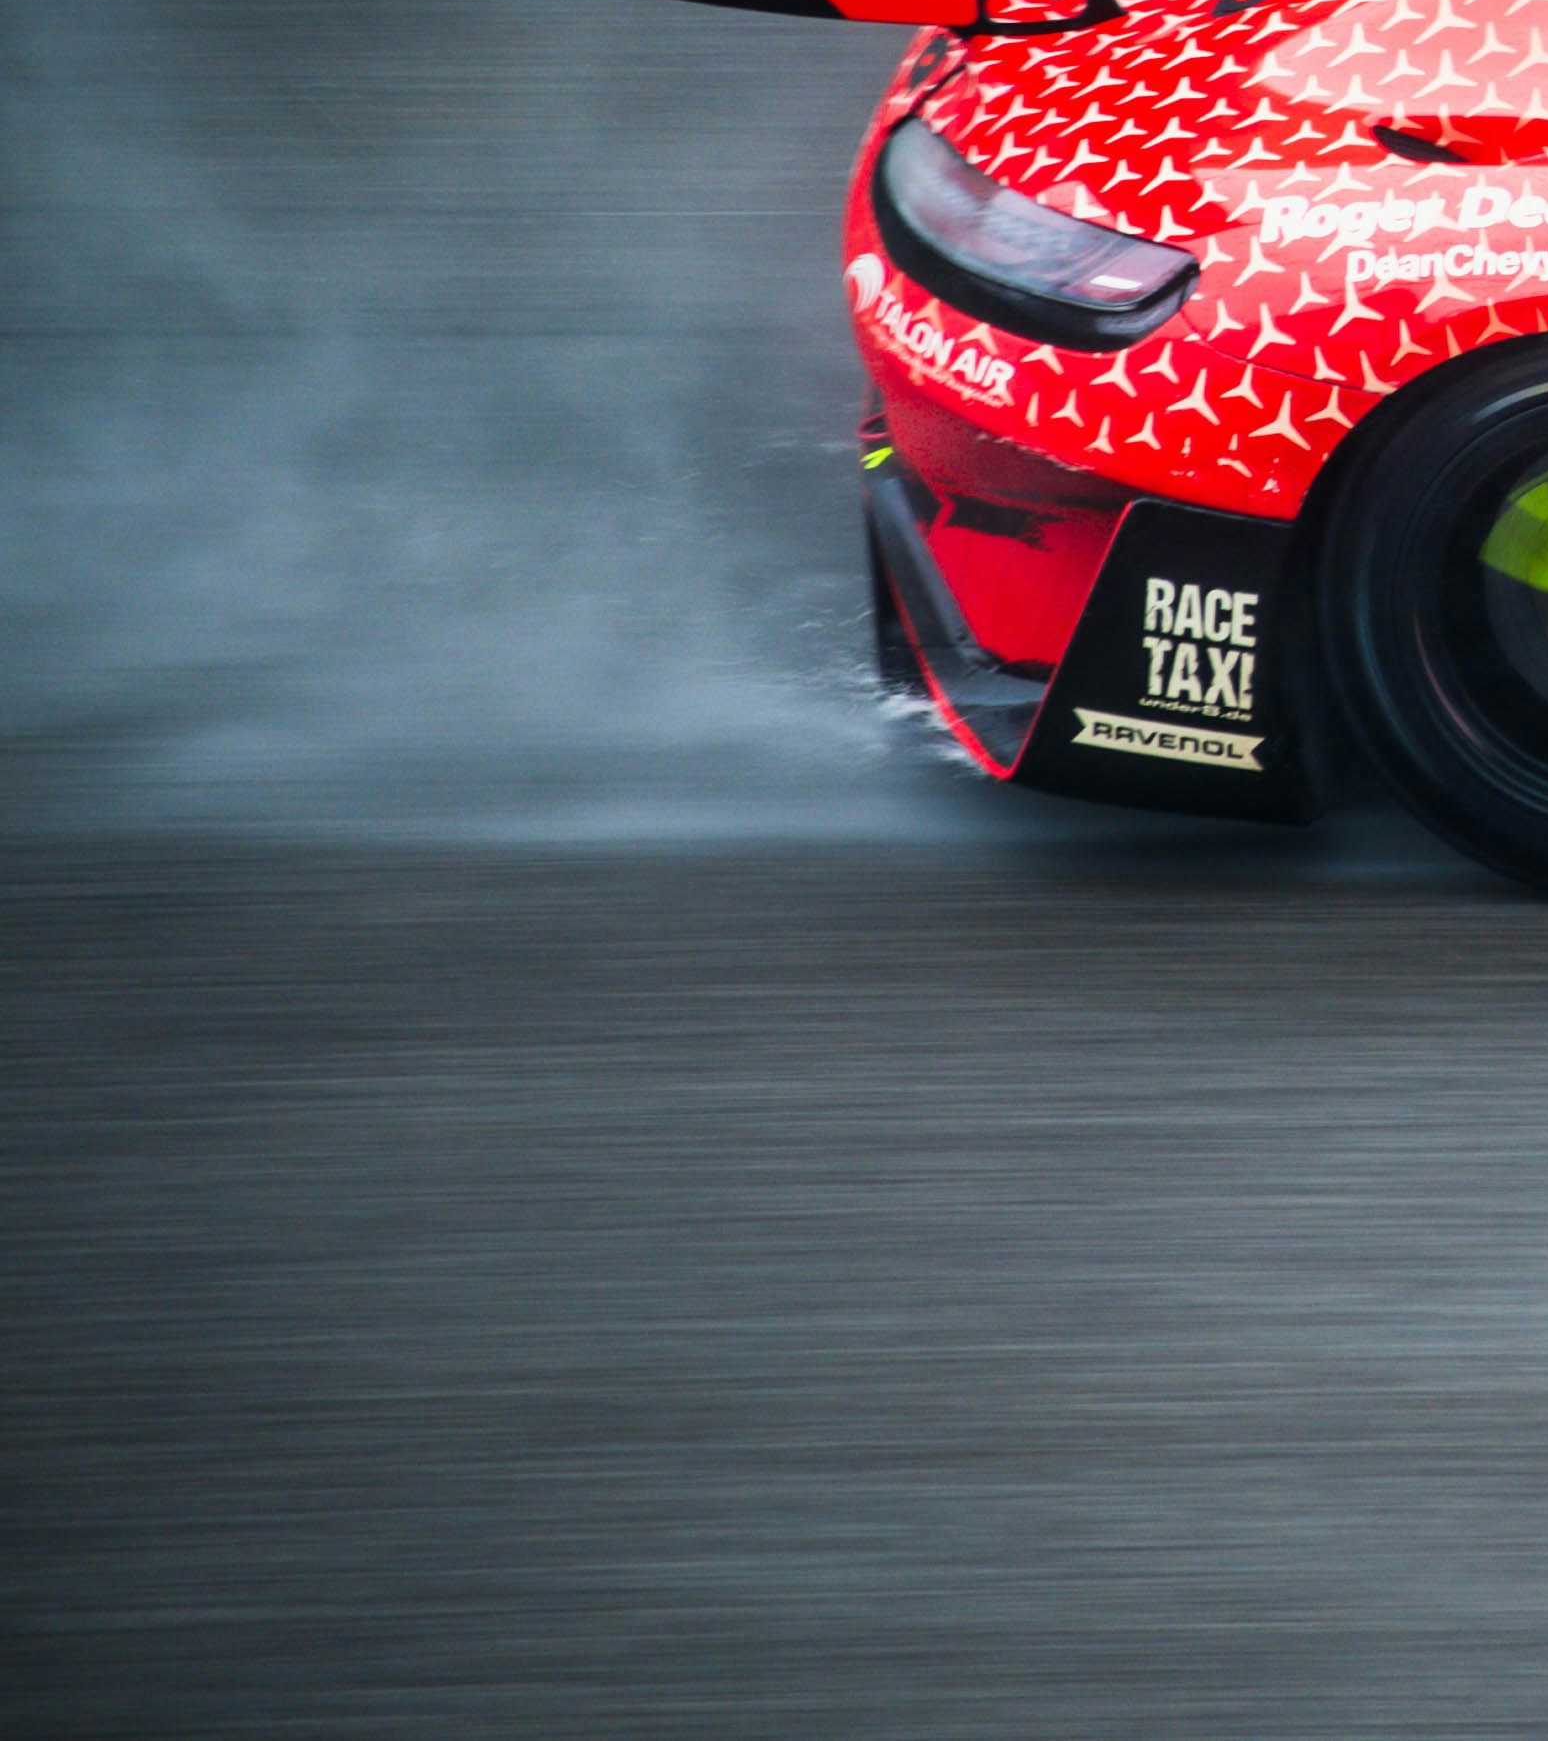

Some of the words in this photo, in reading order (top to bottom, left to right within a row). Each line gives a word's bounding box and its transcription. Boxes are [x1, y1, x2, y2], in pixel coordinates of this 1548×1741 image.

[1258, 194, 1447, 243] Roger
[874, 289, 956, 368] TALON
[950, 347, 1016, 395] AIR
[1143, 577, 1259, 648] RACE
[1142, 635, 1255, 710] TAXI
[1092, 721, 1244, 760] RAVENOL
